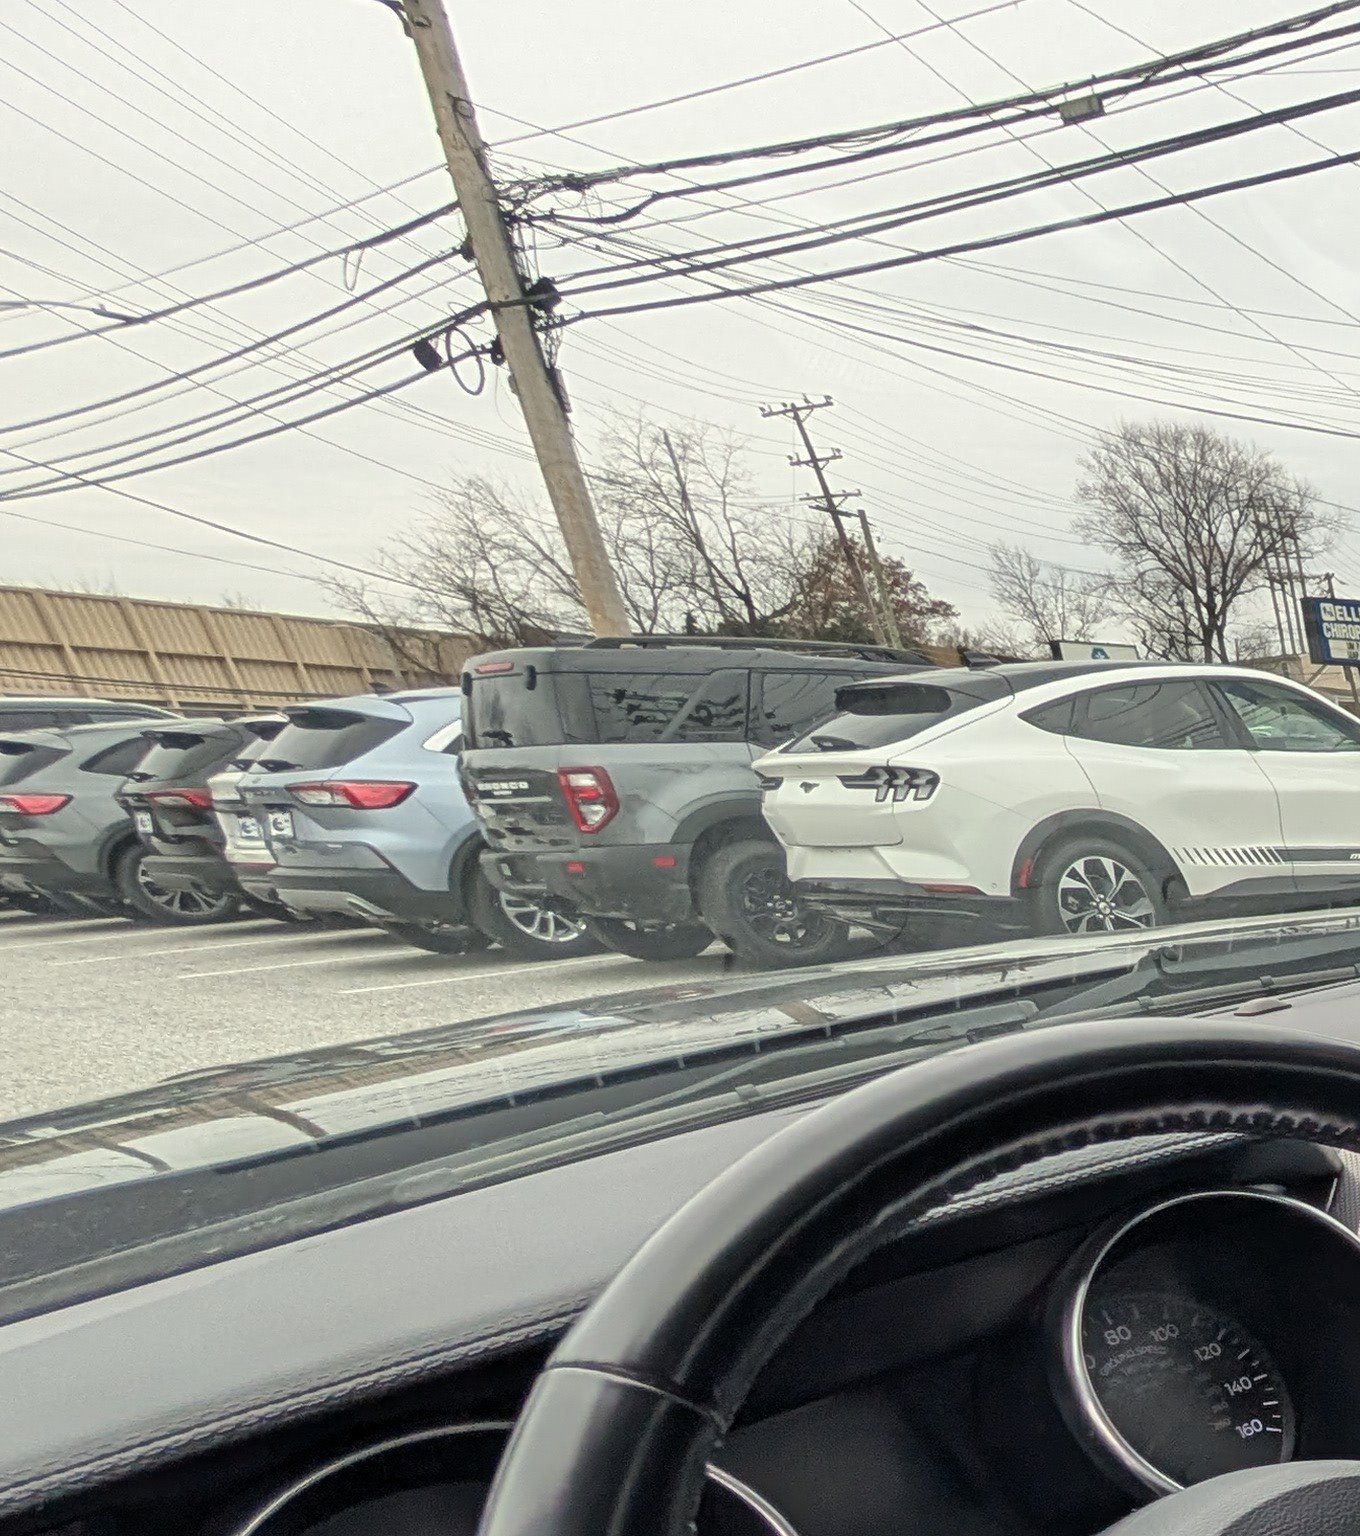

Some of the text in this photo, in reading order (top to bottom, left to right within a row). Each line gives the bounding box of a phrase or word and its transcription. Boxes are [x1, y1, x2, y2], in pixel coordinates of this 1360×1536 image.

[1104, 1325, 1132, 1346] 80
[1150, 1323, 1179, 1342] 100
[1194, 1342, 1222, 1362] 120
[1223, 1376, 1252, 1396] 140
[1235, 1418, 1263, 1439] 160
